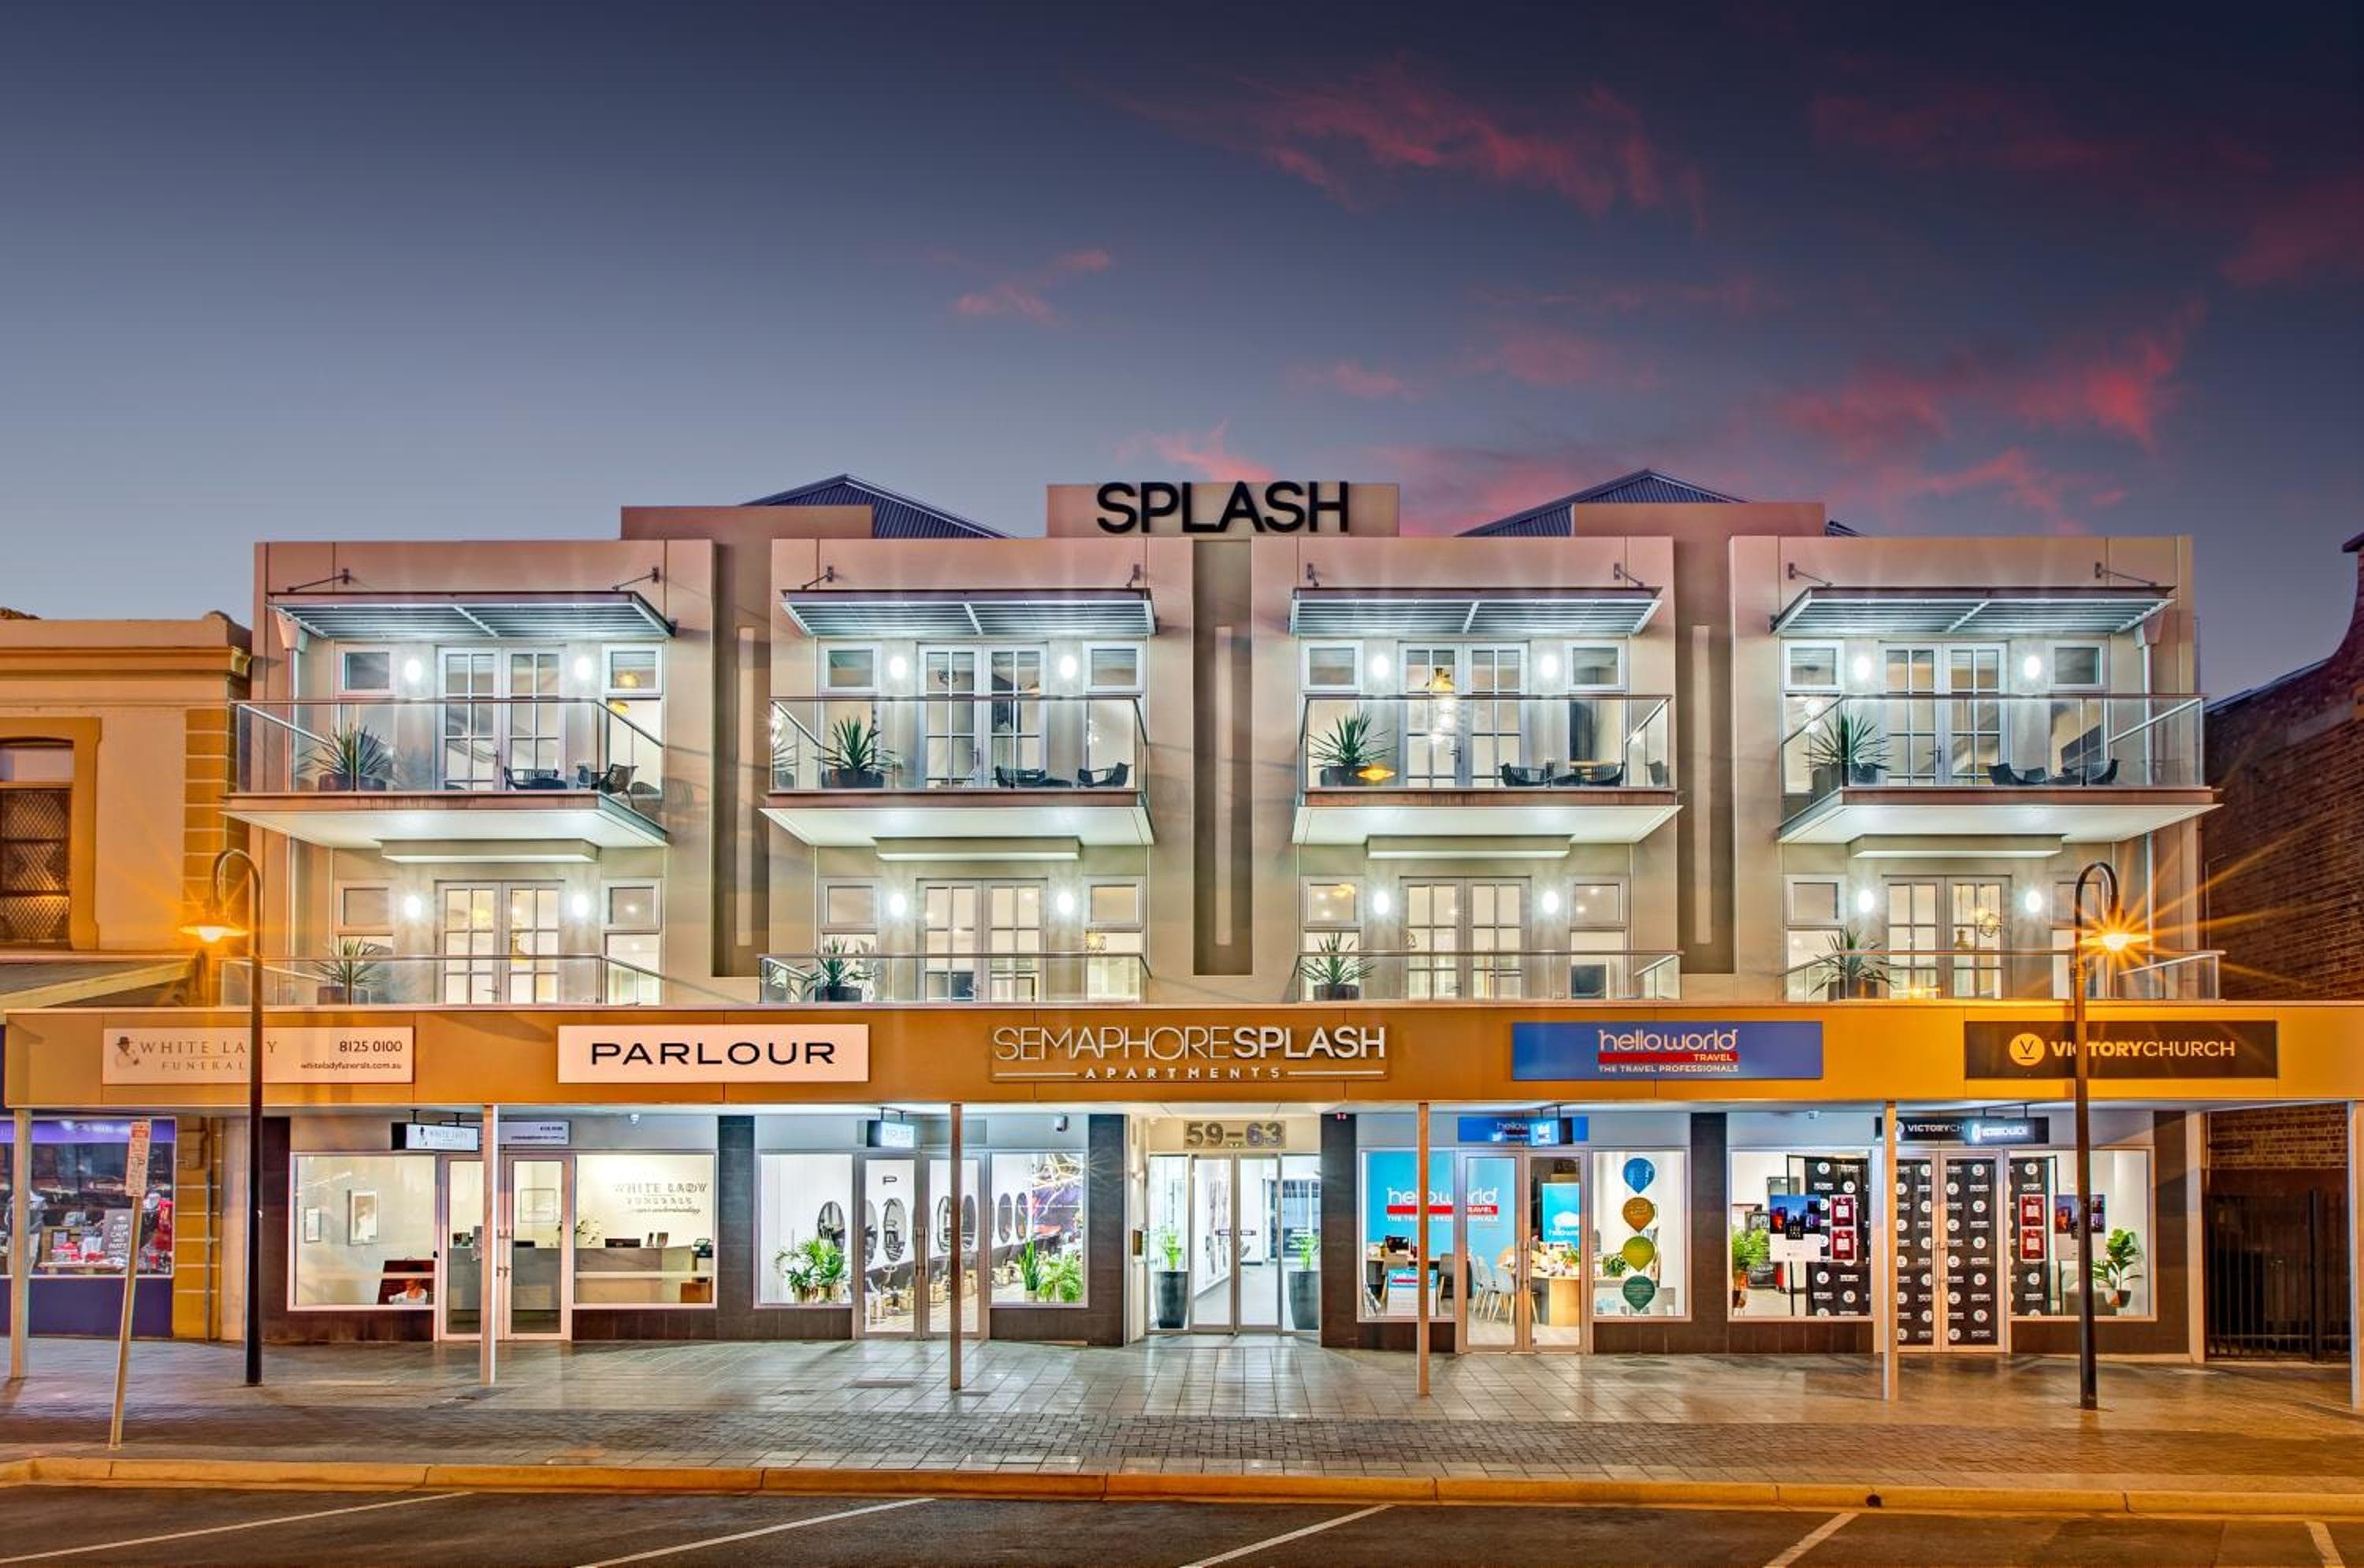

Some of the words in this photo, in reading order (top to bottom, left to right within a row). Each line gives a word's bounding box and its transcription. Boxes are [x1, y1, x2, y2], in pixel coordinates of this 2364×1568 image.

[1096, 481, 1350, 533] SPLASH
[1597, 1028, 1739, 1051] helloworld
[139, 1041, 210, 1054] WHITE
[222, 1041, 278, 1054] LAY
[339, 1040, 369, 1053] 8125
[372, 1040, 403, 1053] 0100
[2050, 1040, 2236, 1057] VITORYCHURCH
[591, 1042, 836, 1065] PARLOUR
[161, 1061, 246, 1071] FUNERAL
[300, 1061, 402, 1072] whiteladyfunerals.com.au
[1084, 1067, 1281, 1080] APARTMENTS
